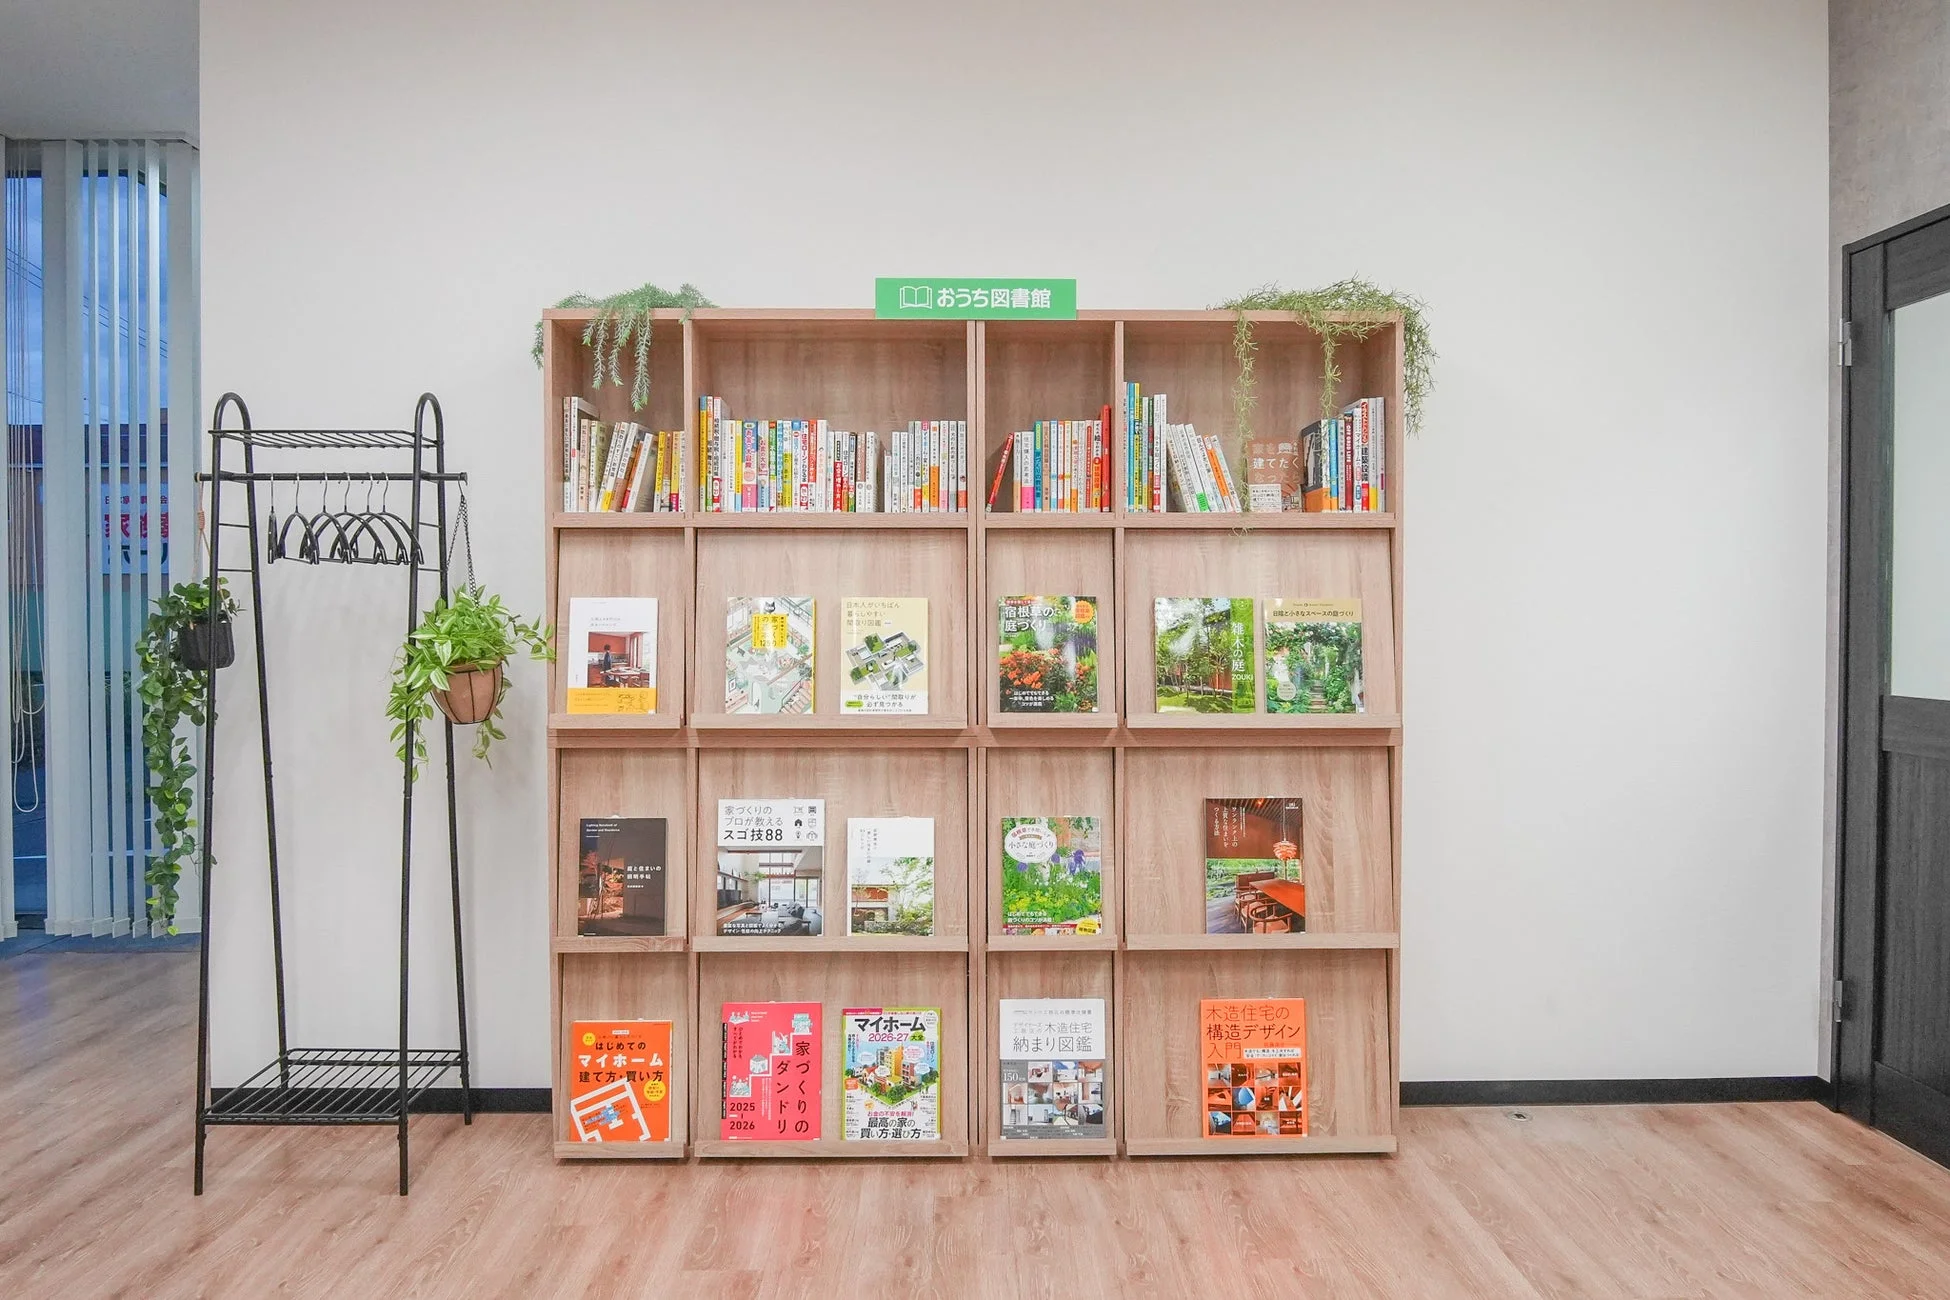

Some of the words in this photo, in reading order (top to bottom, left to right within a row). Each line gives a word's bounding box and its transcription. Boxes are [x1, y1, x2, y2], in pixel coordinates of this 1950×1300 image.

[937, 288, 1051, 308] おうち図書館
[1253, 457, 1299, 469] 建てたく
[1005, 606, 1055, 618] 宿根草の
[1005, 620, 1046, 632] 庭づくり
[1232, 622, 1245, 672] 雑木の庭
[724, 806, 772, 816] 家づくりの
[724, 817, 783, 827] プロが教える
[723, 829, 783, 841] スゴ技88
[1008, 841, 1054, 849] 小さな庭づくり
[1206, 1004, 1290, 1022] 木造住宅の
[855, 1016, 926, 1033] マイホーム
[1045, 1022, 1092, 1034] 木造住宅
[868, 1033, 909, 1042] 2026-27
[1206, 1023, 1301, 1041] 構造デザイン
[595, 1042, 646, 1051] はじめての
[1013, 1036, 1092, 1053] 納まり図鑑
[1207, 1042, 1241, 1059] 入門
[578, 1053, 663, 1068] マイホーム
[579, 1071, 664, 1083] 建て方・買い方
[1003, 1072, 1018, 1081] 150
[795, 1041, 810, 1133] 家づくりの
[776, 1060, 791, 1134] ダンドリ
[730, 1102, 756, 1112] 2025
[729, 1121, 756, 1130] 2026
[867, 1117, 916, 1128] 最高の家の
[860, 1128, 922, 1139] 買い方・選び方
